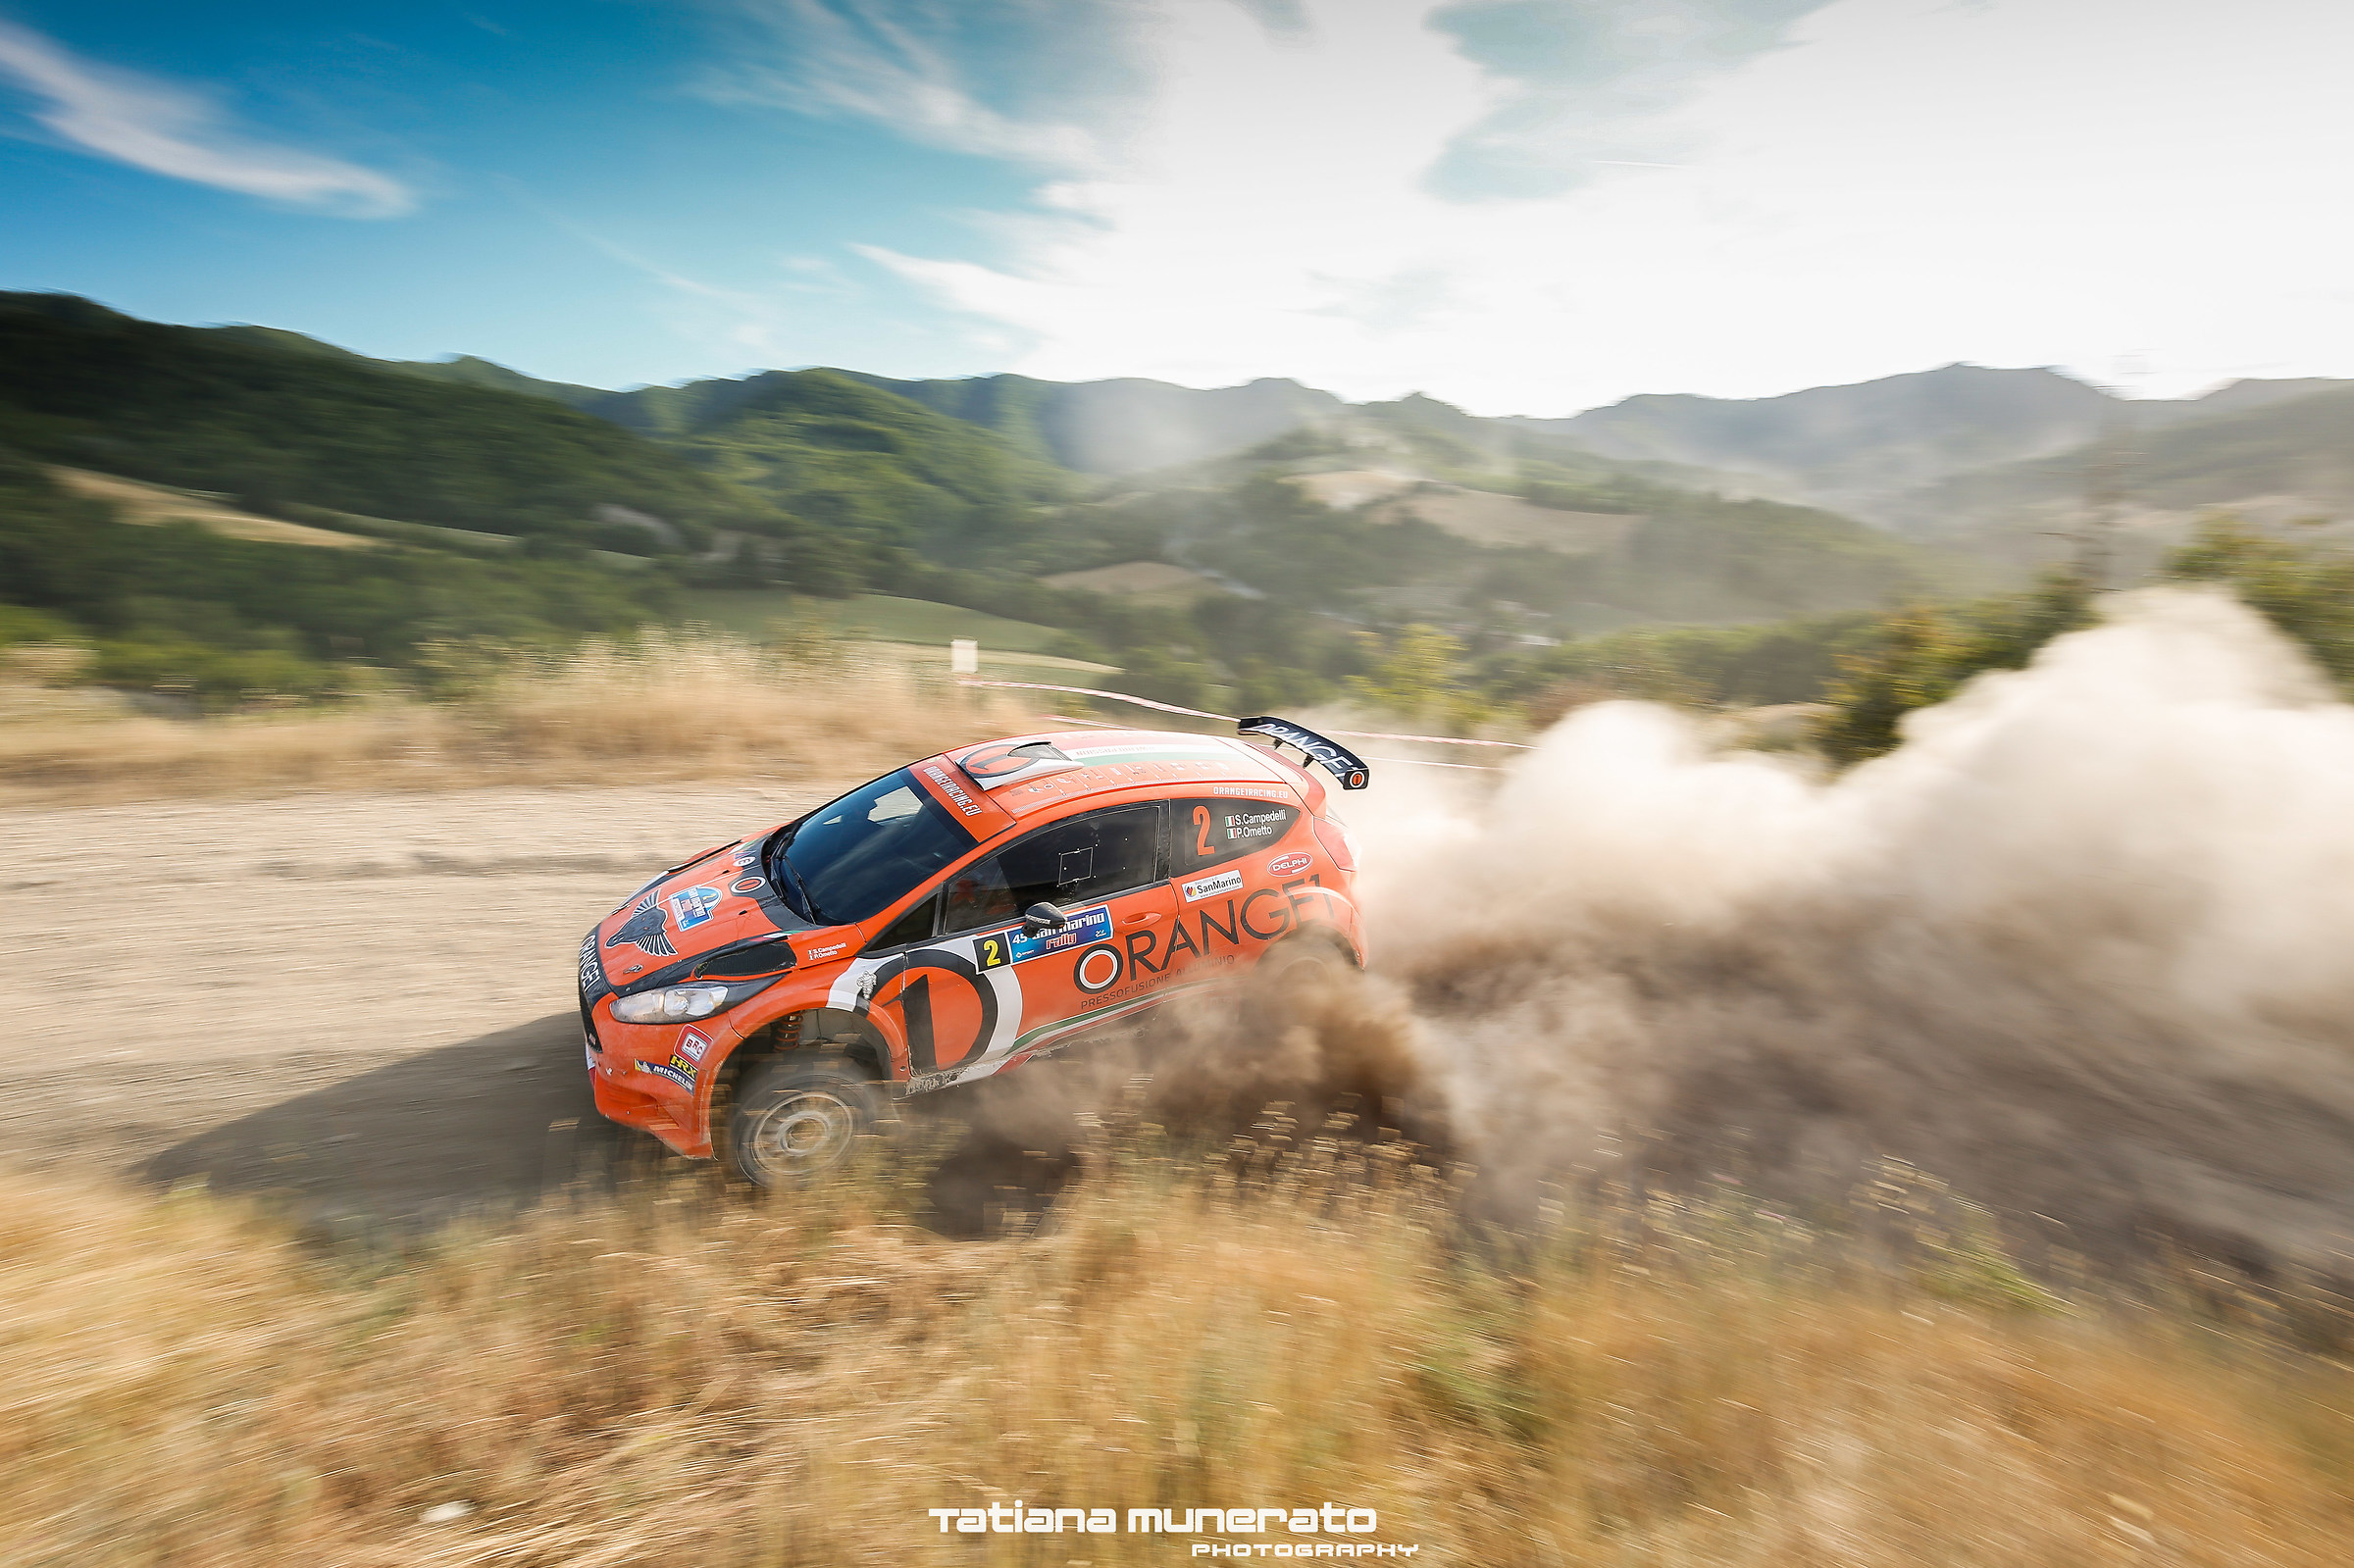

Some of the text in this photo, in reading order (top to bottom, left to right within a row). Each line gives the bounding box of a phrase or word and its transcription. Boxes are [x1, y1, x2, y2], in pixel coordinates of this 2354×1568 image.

[923, 766, 983, 816] ORANGE1RACING.EU
[1213, 786, 1289, 799] ORANGE1RACING.EU
[1234, 809, 1287, 826] S.Campedelli
[1193, 805, 1215, 855] 2
[1236, 826, 1273, 839] P.Ometto
[1272, 857, 1308, 872] DELPHI
[1197, 876, 1242, 894] SanMarino
[1011, 933, 1028, 944] 45
[1046, 933, 1078, 950] rally
[1073, 873, 1335, 994] ORANGE1
[983, 939, 1001, 967] 2
[1081, 974, 1170, 1009] PRESSOFUSIONE
[686, 1038, 703, 1055] BRC
[671, 1055, 697, 1078] HRX
[653, 1065, 694, 1091] MICHELIN
